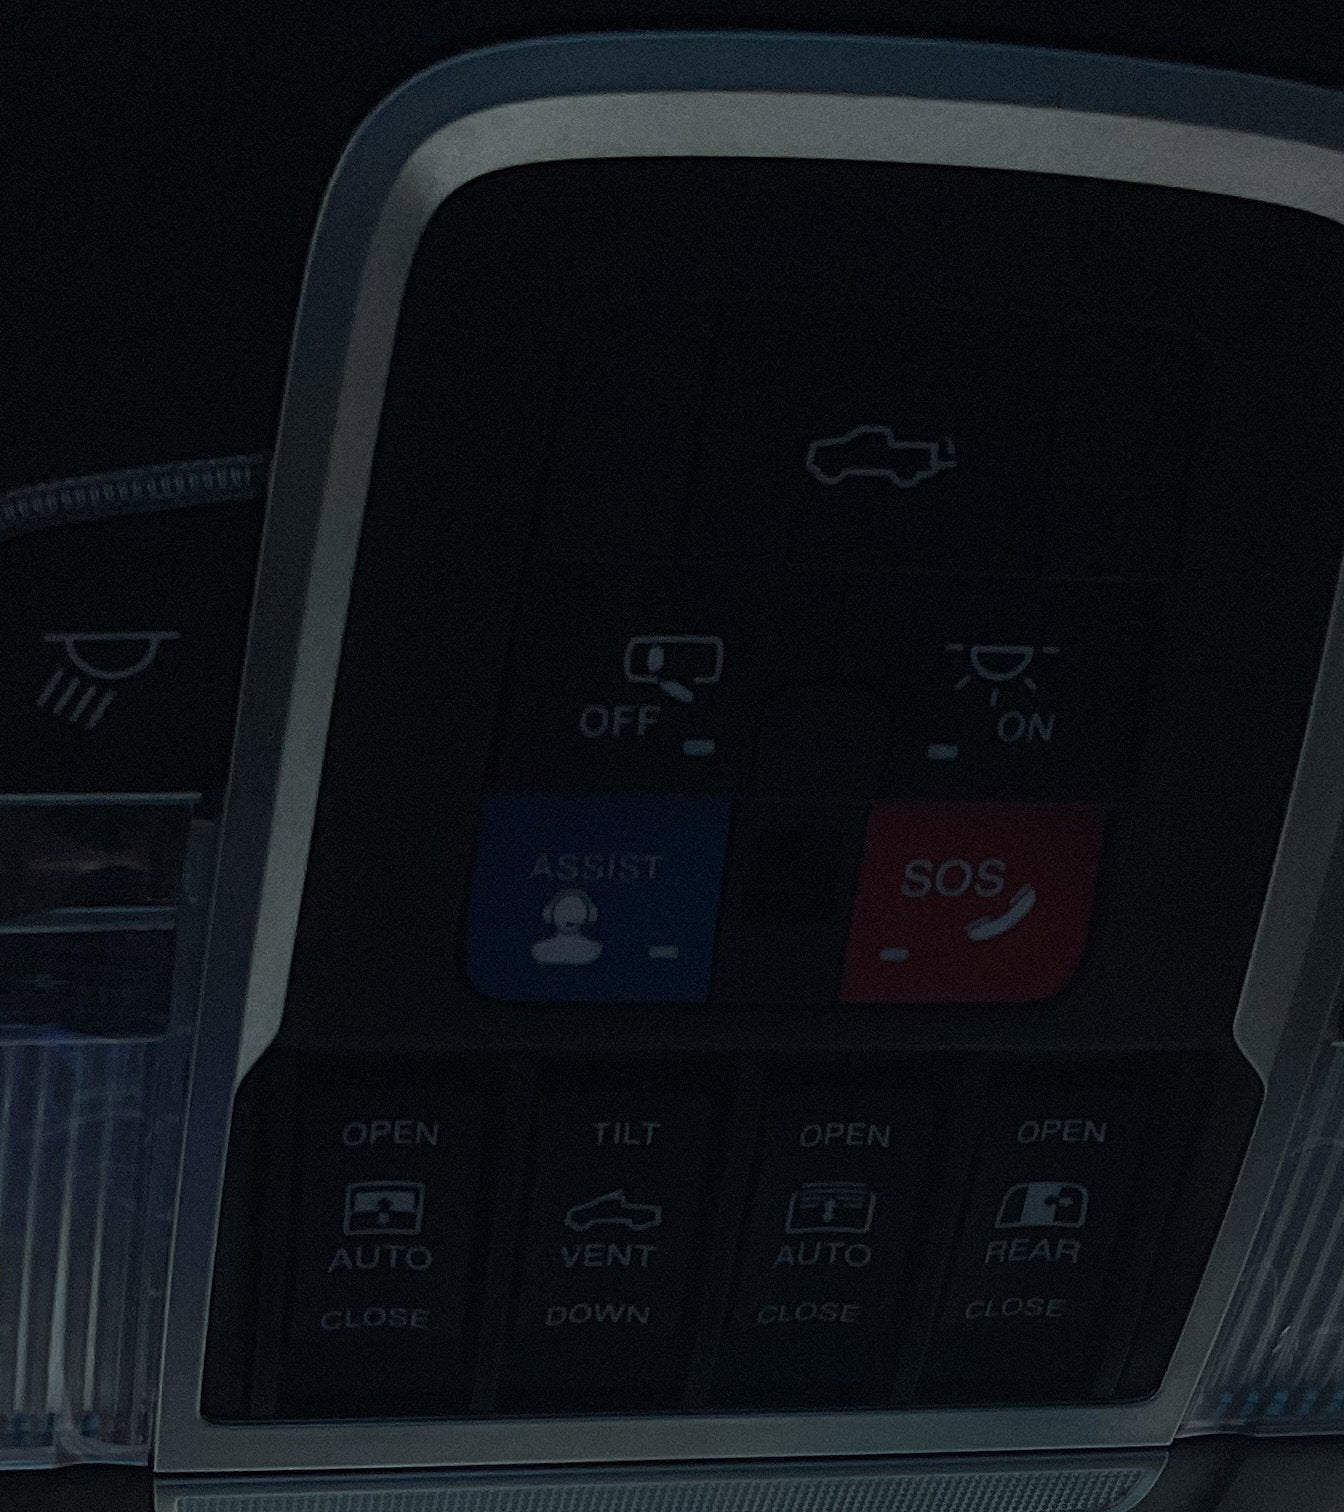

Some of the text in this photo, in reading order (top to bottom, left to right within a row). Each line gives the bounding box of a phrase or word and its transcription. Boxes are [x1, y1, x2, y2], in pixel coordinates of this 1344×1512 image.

[579, 705, 660, 738] OFF
[997, 711, 1057, 743] ON
[530, 852, 663, 883] ASSIST
[901, 858, 1007, 898] SOS
[342, 1120, 440, 1147] OPEN
[591, 1121, 661, 1146] TILT
[799, 1122, 891, 1148] OPEN
[1017, 1120, 1107, 1144] OPEN
[327, 1246, 433, 1273] AUTO
[560, 1243, 657, 1268] VENT
[773, 1241, 872, 1268] AUTO
[985, 1238, 1081, 1264] REAR
[321, 1306, 430, 1330] CLOSE
[546, 1303, 650, 1326] DOWN
[757, 1301, 861, 1324] CLOSE
[966, 1298, 1067, 1320] CLOSE
